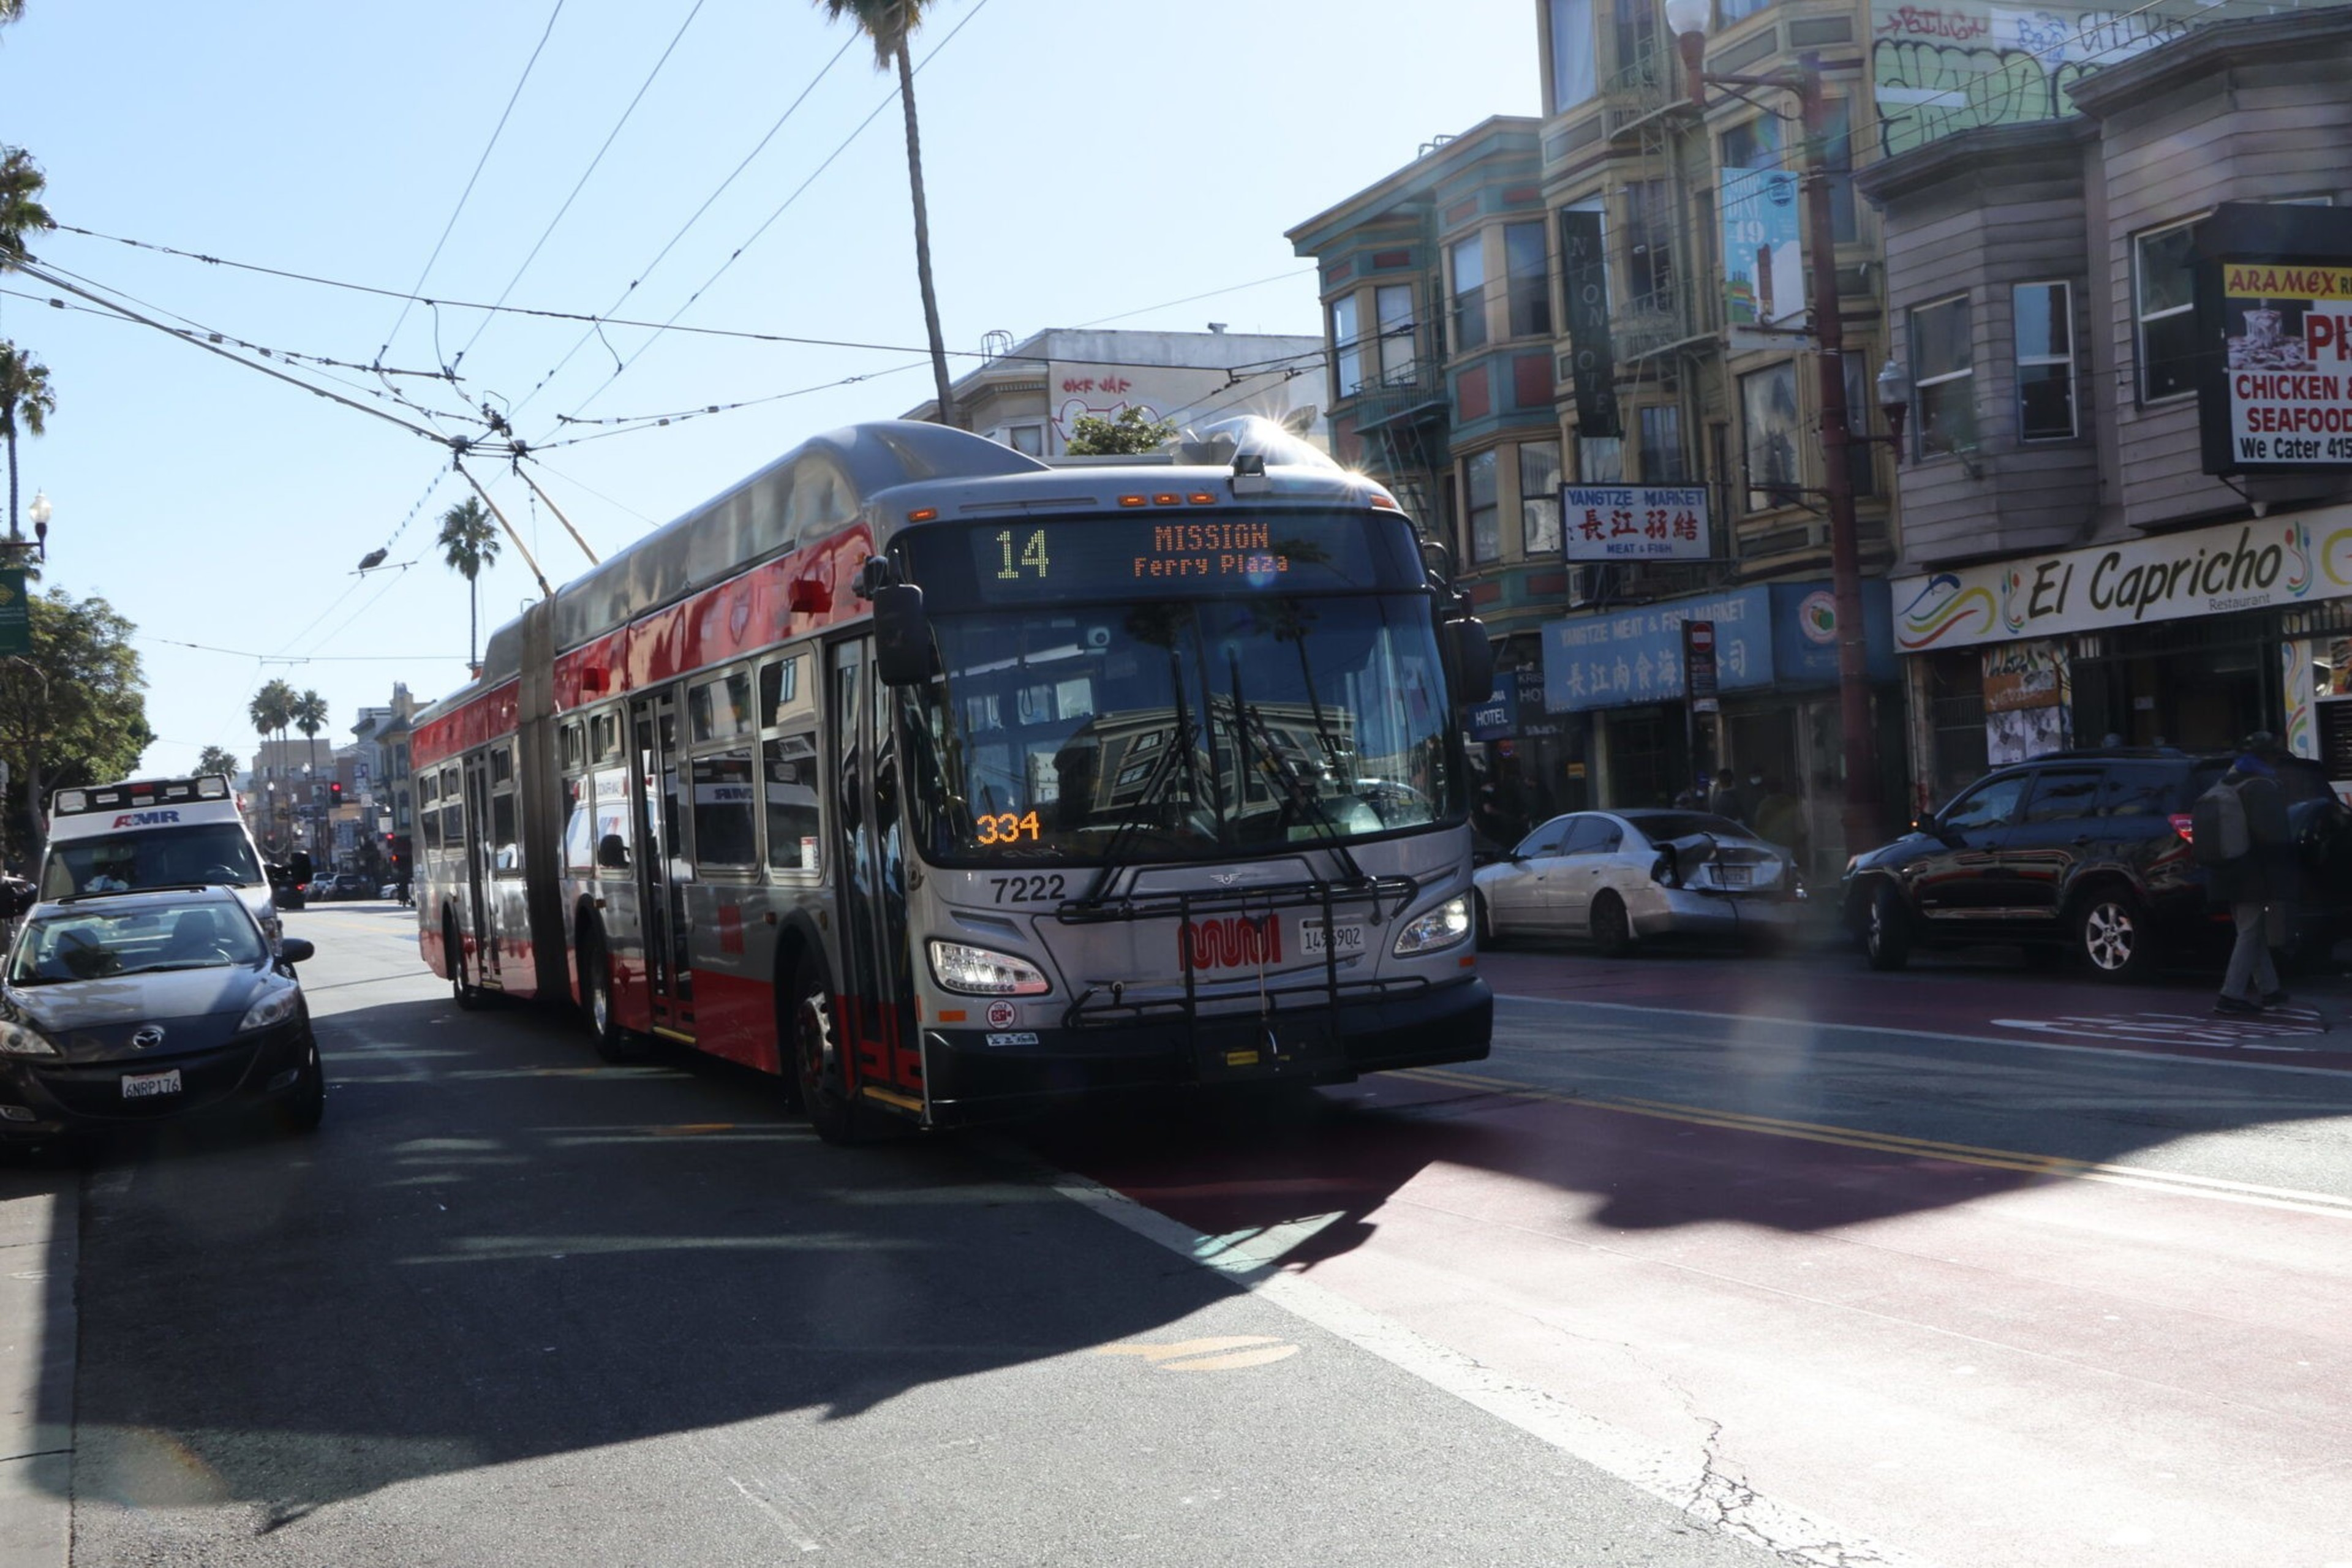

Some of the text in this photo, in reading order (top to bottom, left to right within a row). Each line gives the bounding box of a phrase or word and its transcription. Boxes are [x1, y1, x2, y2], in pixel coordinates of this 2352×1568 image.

[2229, 270, 2335, 296] ARAMEX
[2305, 315, 2352, 361] PI
[2236, 375, 2339, 400] CHICKEN
[2240, 437, 2266, 459] We
[2274, 437, 2321, 459] Cater
[1567, 491, 1703, 506] YANGTZE MARKET
[996, 523, 1268, 578] 14 MISSION
[1607, 543, 1634, 554] MEAT
[1647, 543, 1672, 554] FISH
[1134, 554, 1289, 577] Ferry Plaza
[2028, 526, 2283, 620] El Capricho
[2208, 593, 2271, 611] Restaurant
[1562, 623, 1608, 646] YANGTZE
[1612, 616, 1643, 639] MEAT
[1695, 598, 1745, 624] MARKET
[1518, 688, 1544, 703] HO
[1475, 707, 1509, 727] HOTEL
[112, 810, 179, 829] AMR
[977, 811, 1039, 845] 334
[990, 874, 1066, 903] 7222
[125, 1078, 179, 1099] 6NRP176
